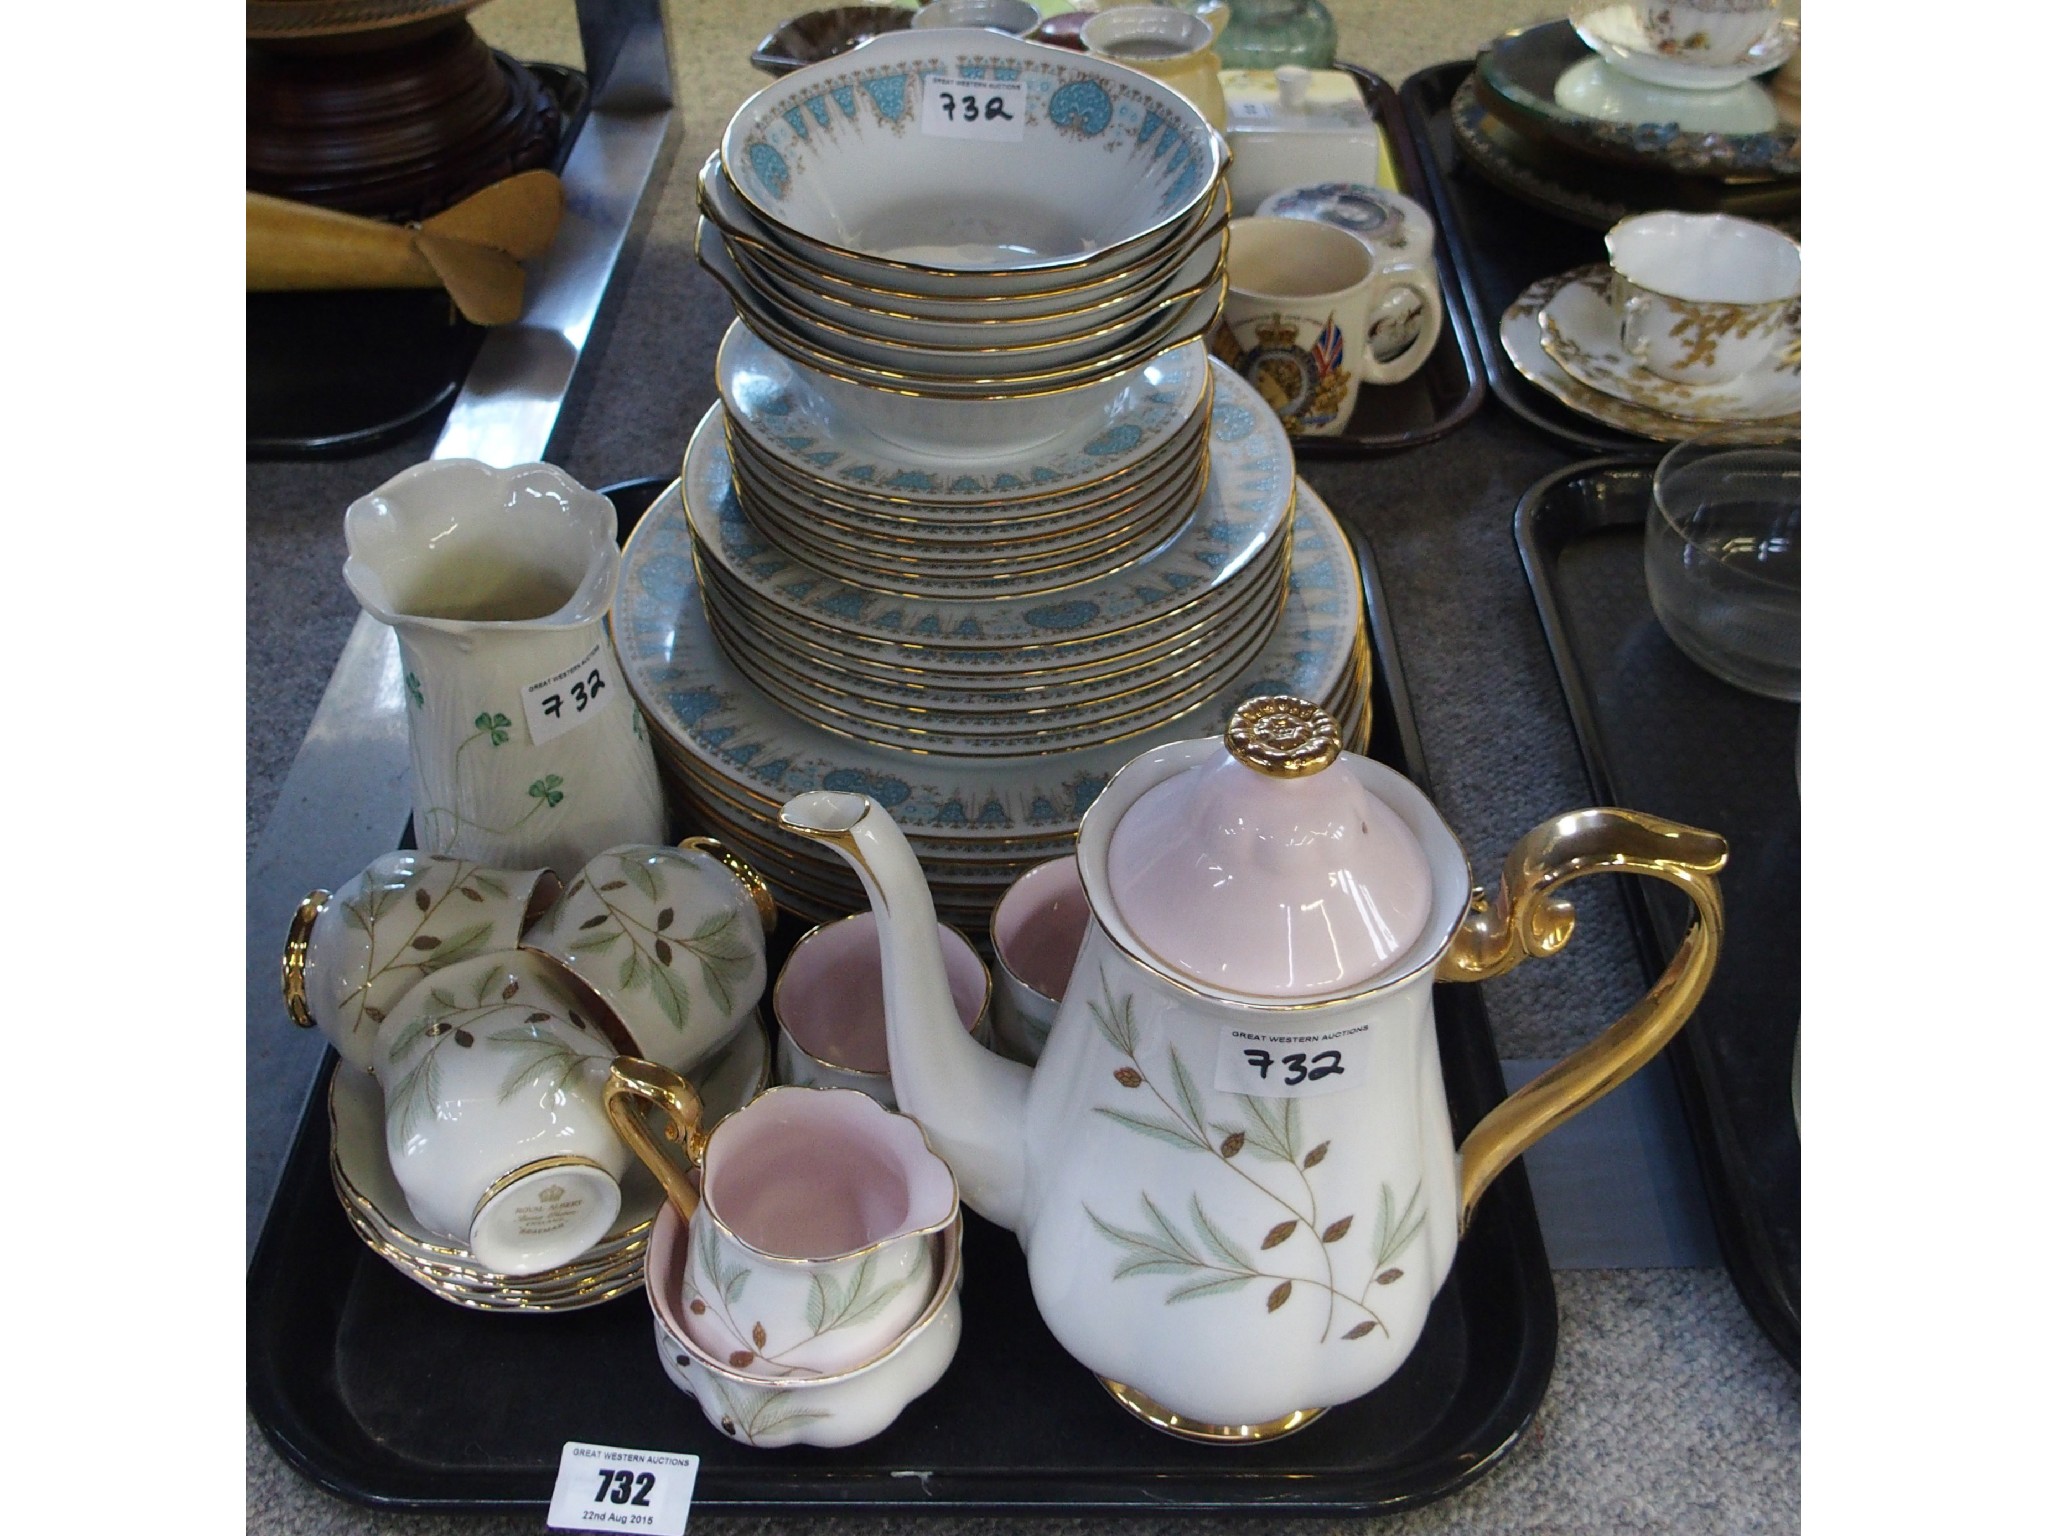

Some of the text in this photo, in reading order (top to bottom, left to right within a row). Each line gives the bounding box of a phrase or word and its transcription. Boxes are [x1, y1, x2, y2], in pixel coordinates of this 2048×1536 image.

[940, 92, 1013, 121] 732
[528, 679, 551, 692] GREAT
[542, 668, 605, 718] 732
[1232, 1031, 1267, 1041] GREAT
[1322, 1024, 1369, 1040] AUCTIONS
[1244, 1049, 1344, 1086] 732
[573, 1448, 689, 1467] GREAT WESTERN AUCTIONS
[594, 1468, 656, 1507] 732
[582, 1510, 653, 1525] 22nd Aug 2015
